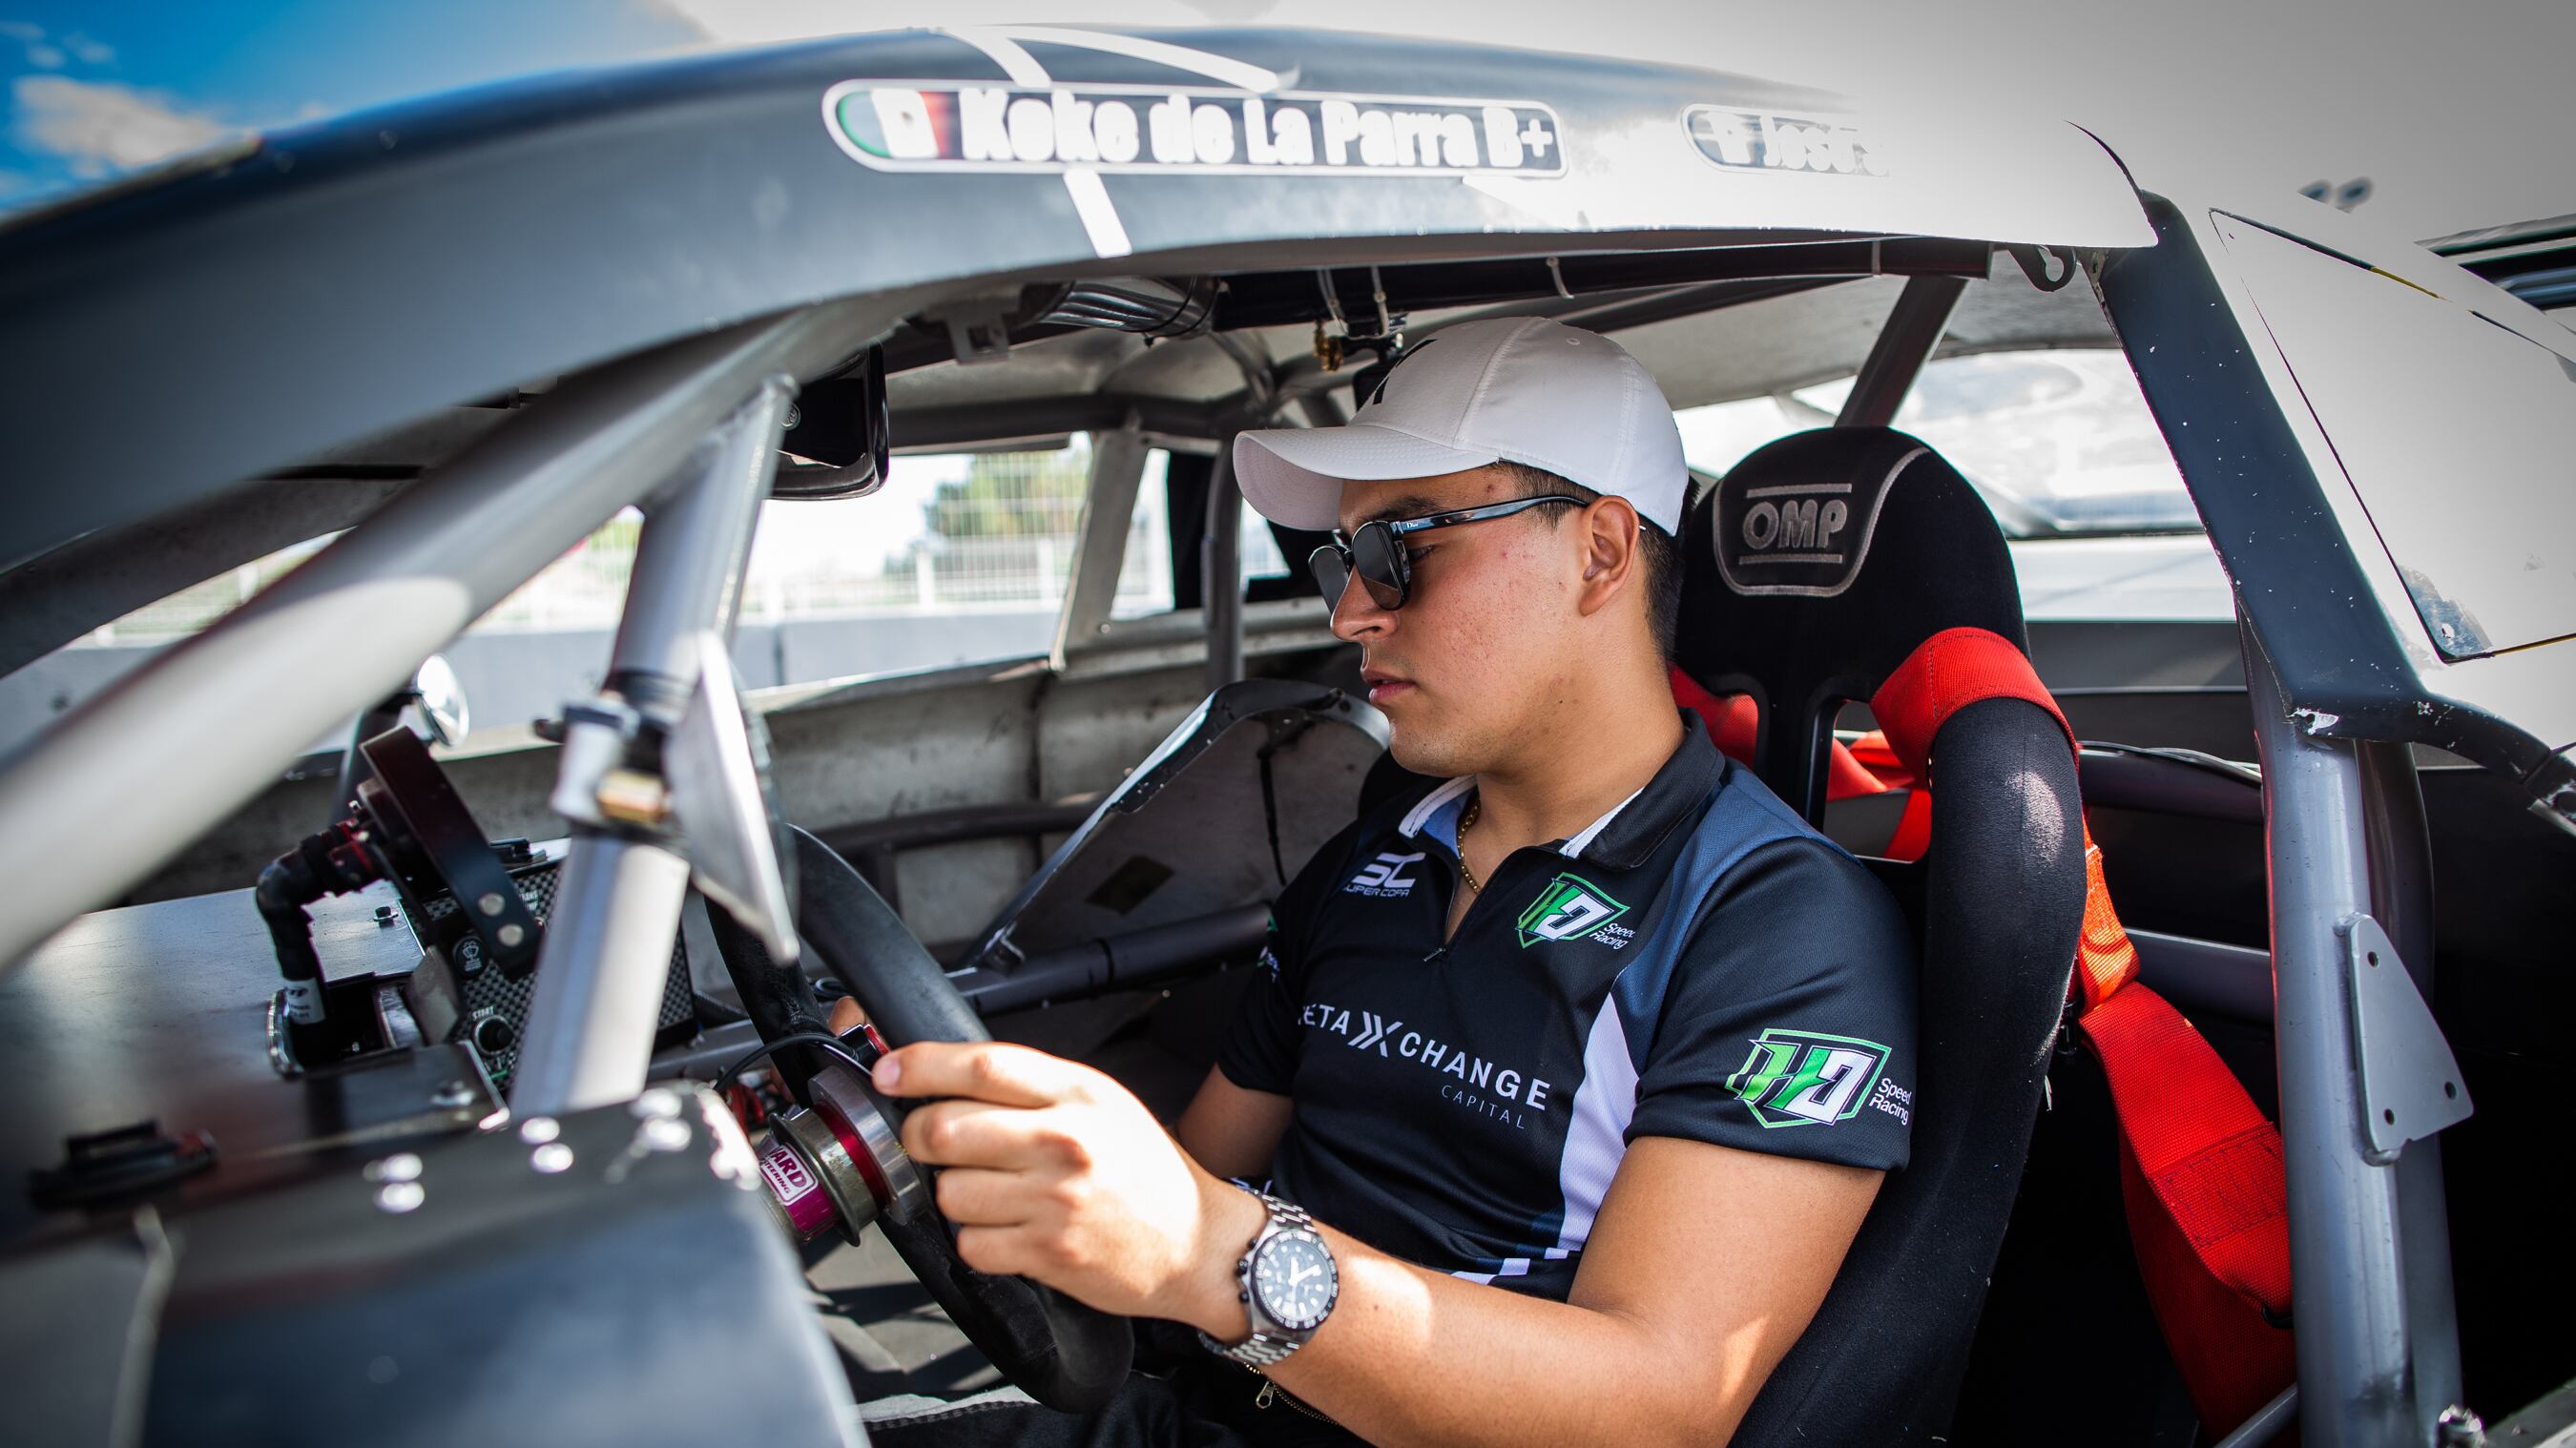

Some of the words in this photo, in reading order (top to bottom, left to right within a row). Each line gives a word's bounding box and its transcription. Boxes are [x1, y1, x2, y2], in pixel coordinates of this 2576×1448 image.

[958, 87, 1140, 163] Koke
[1149, 93, 1235, 164] de
[1242, 97, 1315, 165] La
[1319, 99, 1480, 167] Parra
[1482, 106, 1553, 168] B+
[1742, 499, 1848, 549] OMP
[1381, 888, 1410, 898] COPA
[1589, 930, 1630, 950] Racing
[1442, 1085, 1526, 1129] CAPITAL
[1879, 1077, 1912, 1106] Speed
[1869, 1092, 1909, 1126] Racing
